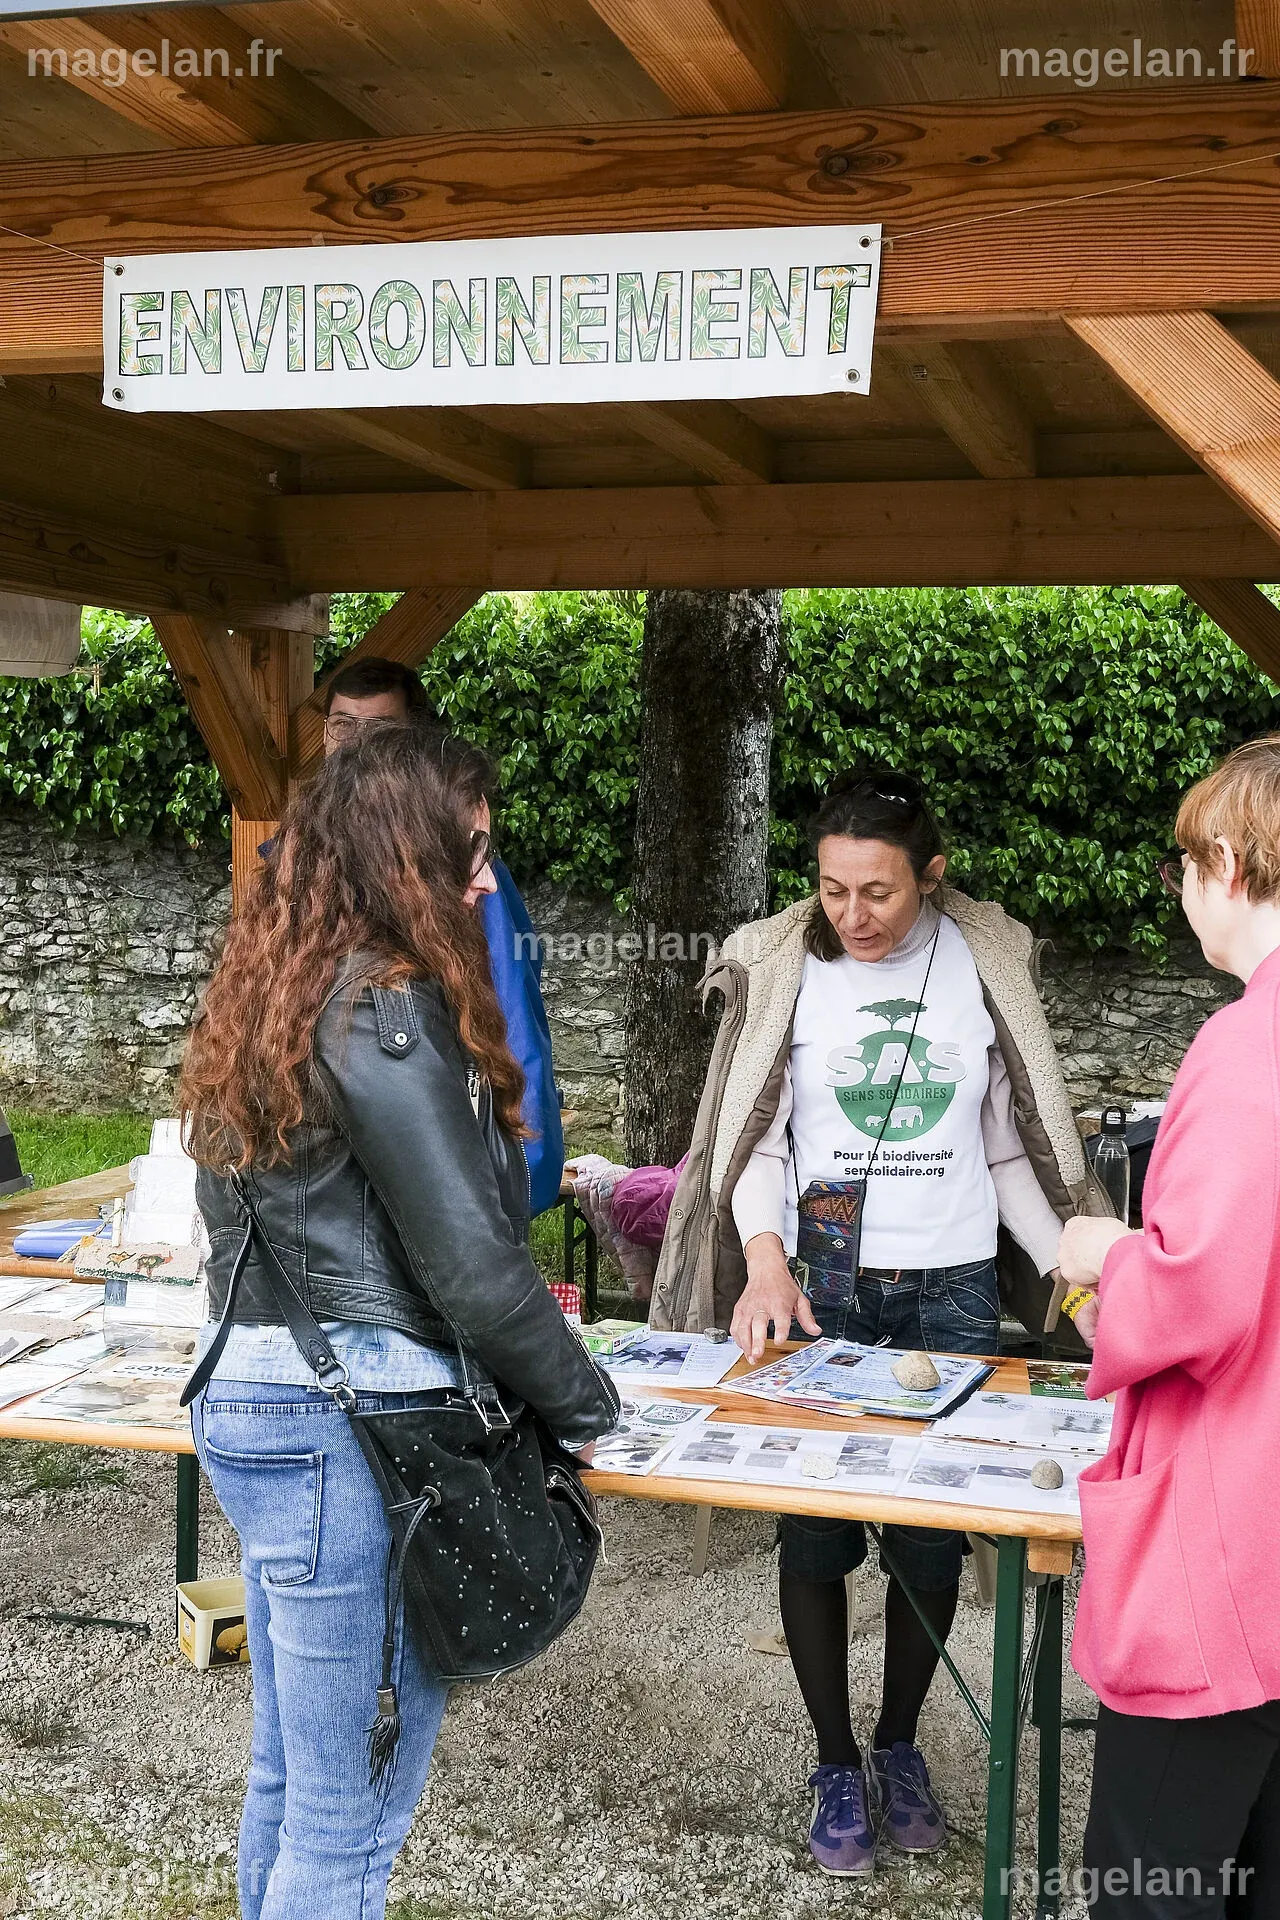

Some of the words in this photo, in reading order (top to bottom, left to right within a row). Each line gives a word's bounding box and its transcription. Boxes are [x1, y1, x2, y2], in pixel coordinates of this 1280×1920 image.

[118, 263, 873, 377] ENVIRONNEMENT
[843, 1090, 875, 1102] SENS
[833, 1150, 864, 1161] Pour
[867, 1150, 879, 1161] la
[882, 1148, 954, 1162] biodiversité
[844, 1165, 945, 1178] sensolidaire.org
